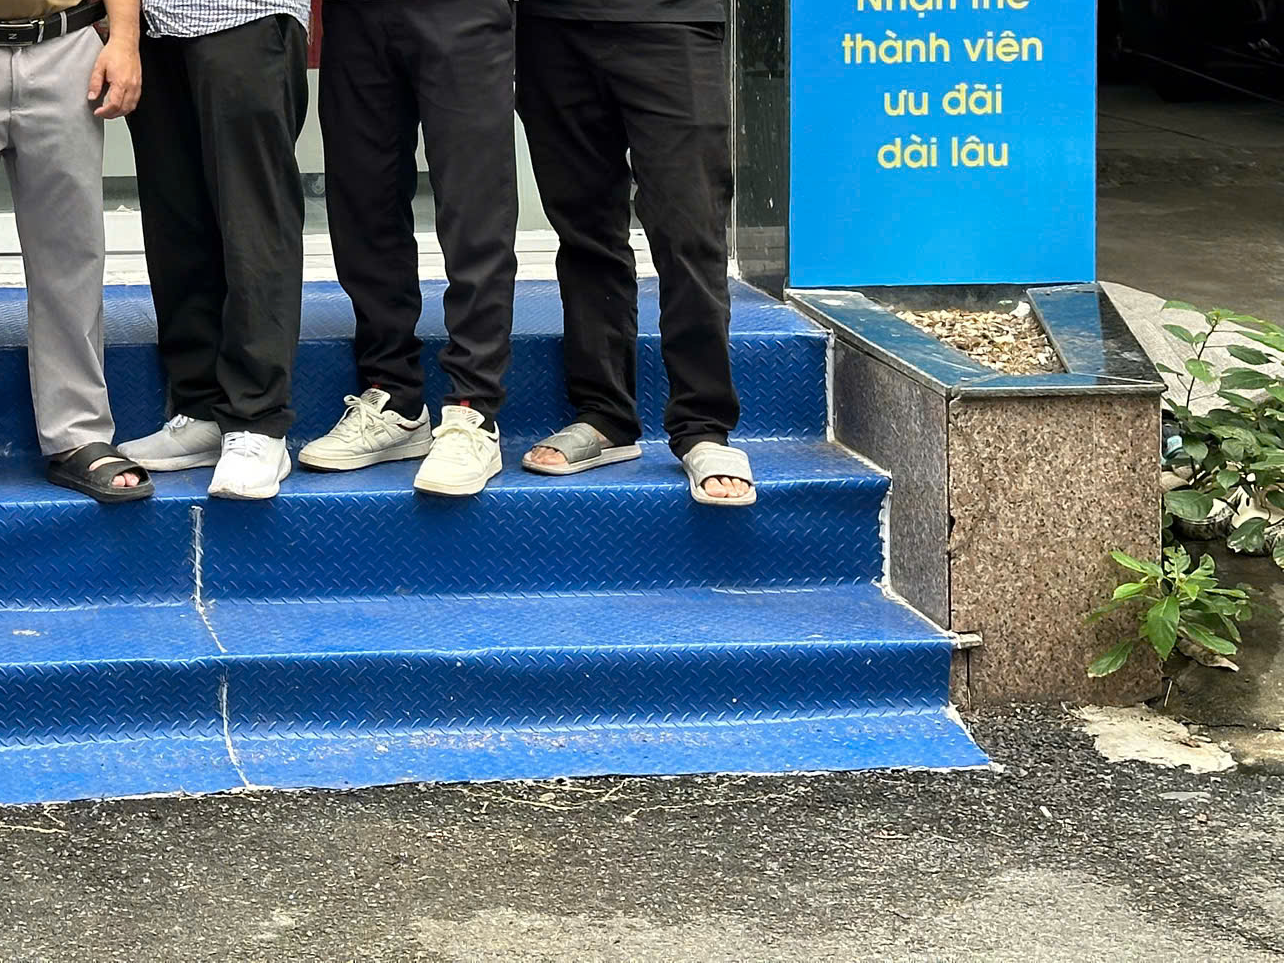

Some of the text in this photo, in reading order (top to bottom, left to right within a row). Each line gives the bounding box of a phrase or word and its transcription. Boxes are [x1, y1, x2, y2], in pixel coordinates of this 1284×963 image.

[842, 30, 1043, 64] thành viên
[883, 83, 1003, 116] ưu đãi
[877, 134, 1009, 169] dài lâu
